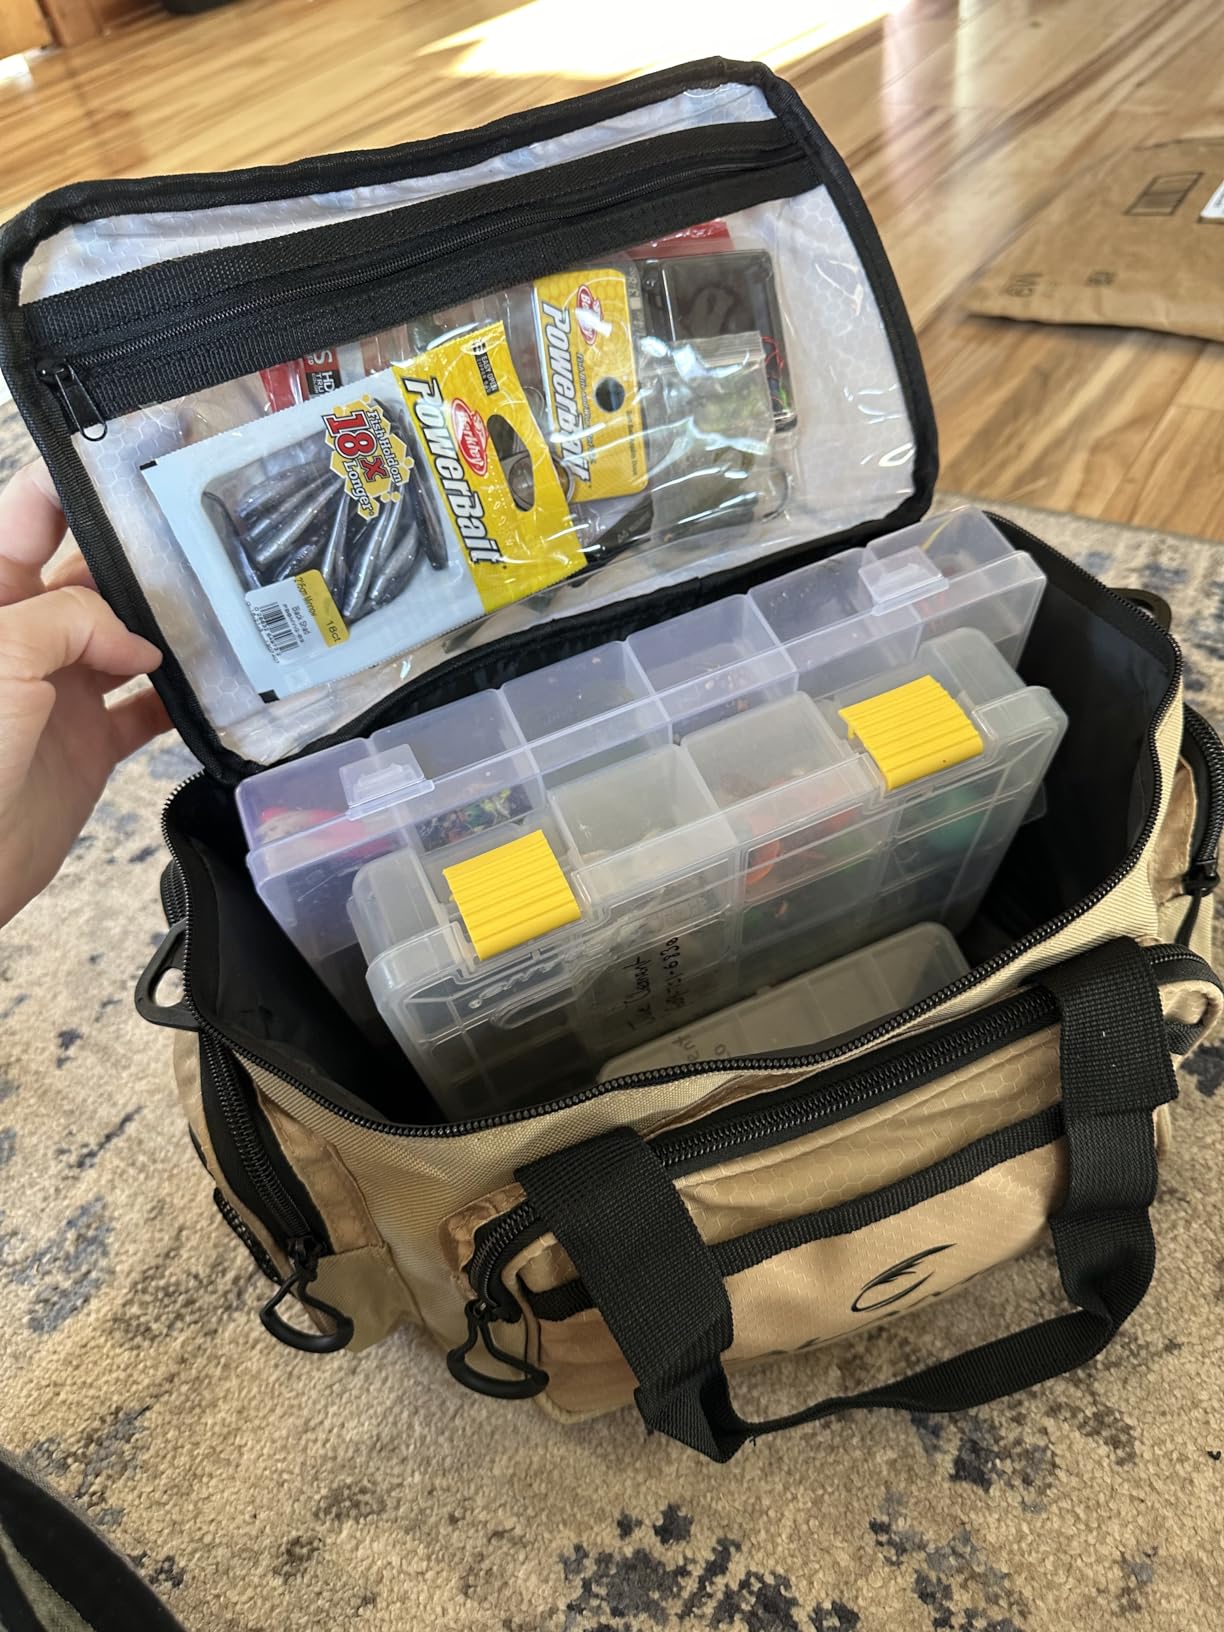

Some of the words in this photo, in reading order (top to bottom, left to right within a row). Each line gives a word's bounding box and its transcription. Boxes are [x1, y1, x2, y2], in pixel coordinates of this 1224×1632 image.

[315, 372, 325, 393] TRU
[321, 371, 335, 392] HD
[481, 355, 491, 373] EASY
[487, 372, 498, 391] OPEN
[366, 410, 383, 437] Fish
[380, 437, 398, 466] Hold
[391, 468, 403, 485] on
[343, 460, 373, 512] Longer
[402, 376, 502, 563] PowerBait
[326, 620, 342, 643] 18ct
